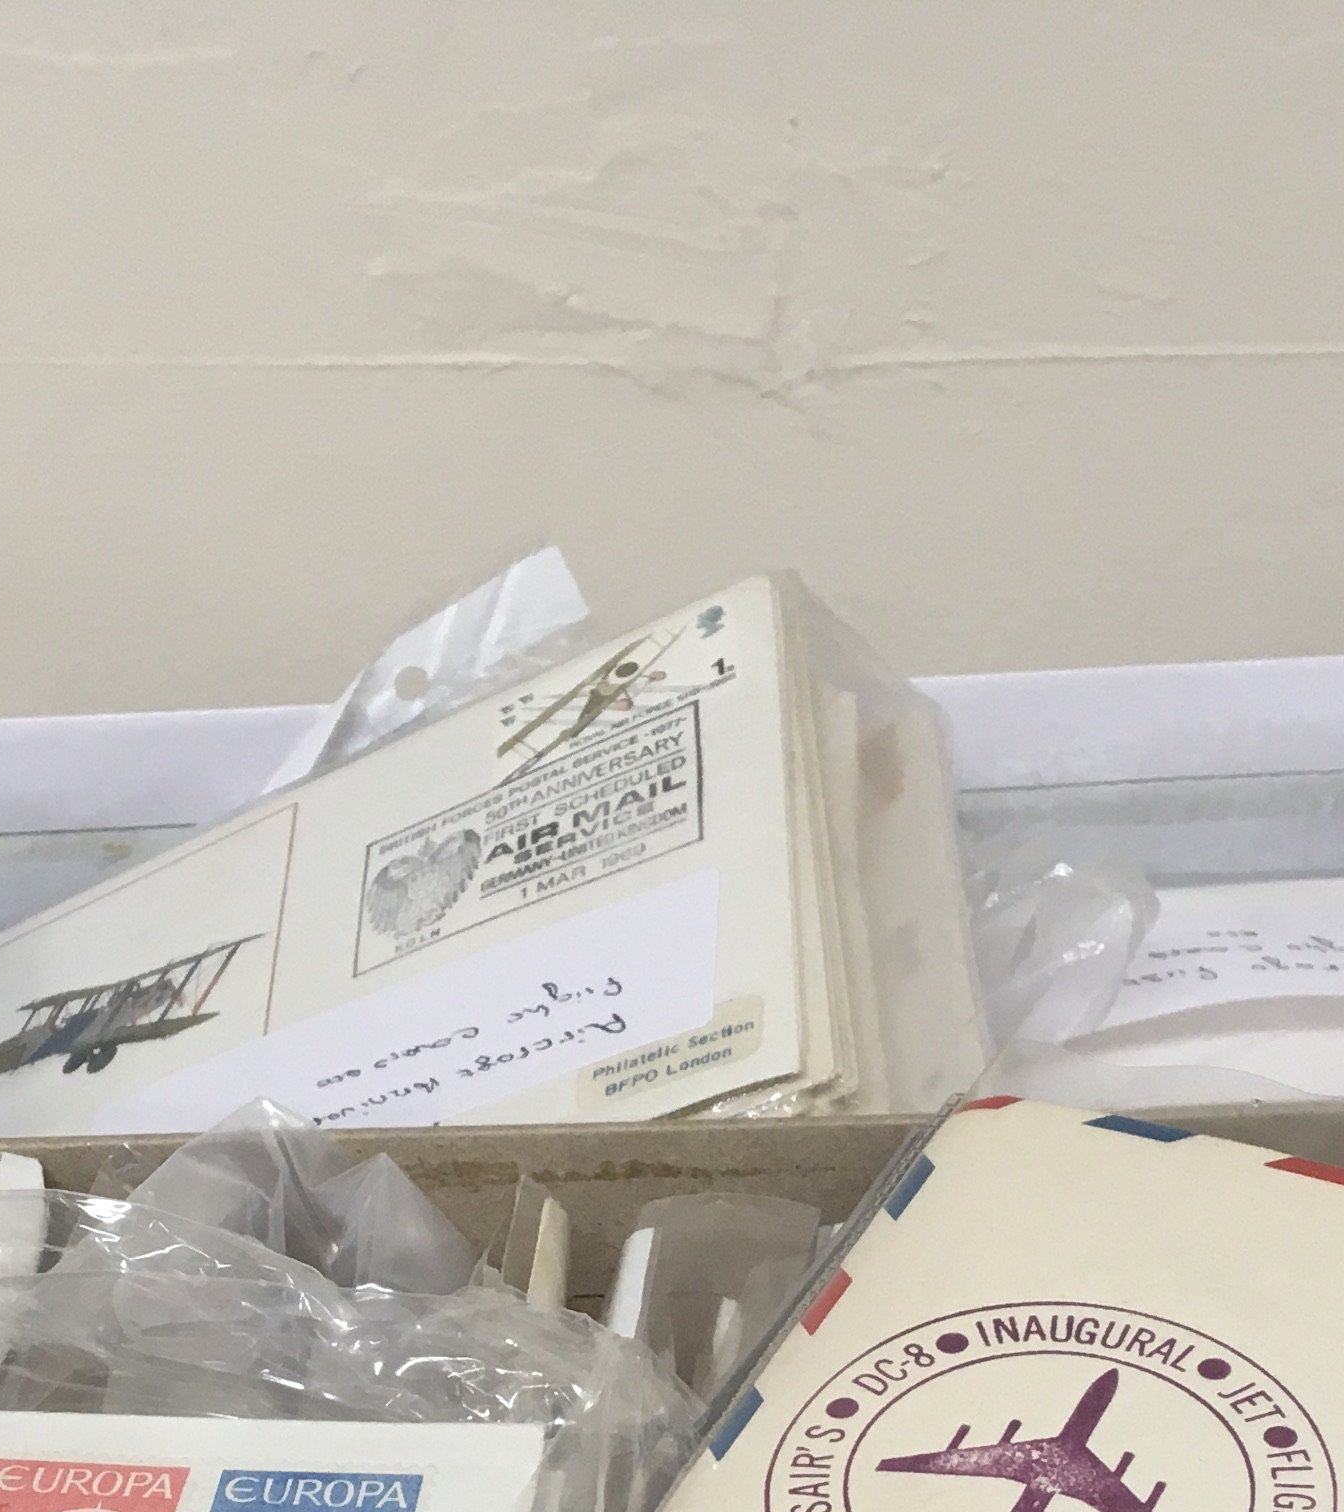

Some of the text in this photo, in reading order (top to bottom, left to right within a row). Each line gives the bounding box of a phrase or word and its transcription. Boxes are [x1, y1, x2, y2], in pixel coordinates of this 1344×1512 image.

[441, 793, 504, 829] FORCES
[507, 766, 567, 800] POSTAL
[572, 735, 640, 769] SERVICE
[484, 755, 687, 845] FIRST SCHEDULED
[532, 732, 685, 806] ANNIVERSARY
[483, 776, 687, 864] AIR MAIL
[513, 802, 655, 865] SERVICE
[536, 864, 587, 895] MAR
[592, 1043, 681, 1081] Philatelic
[605, 1046, 733, 1098] BFPO London
[852, 1342, 936, 1396] DC-8
[976, 1314, 1201, 1373] INAUGURAL
[1217, 1381, 1286, 1424] JET
[224, 1476, 409, 1510] EUROPA
